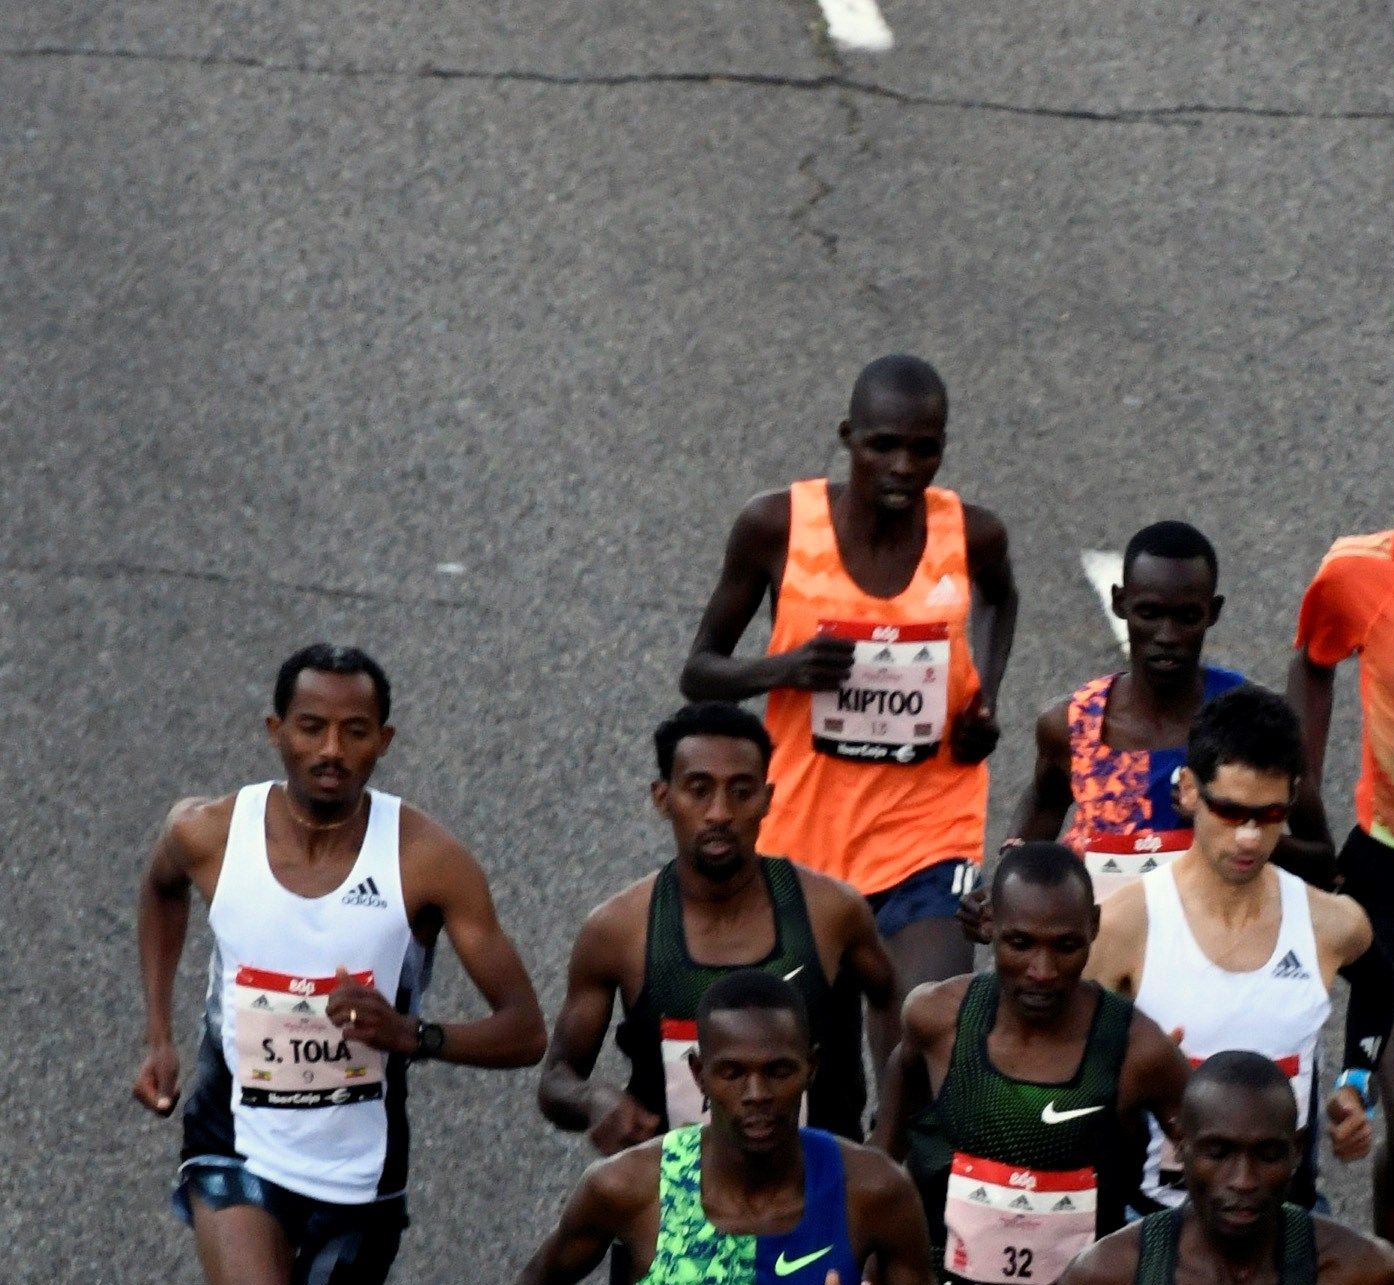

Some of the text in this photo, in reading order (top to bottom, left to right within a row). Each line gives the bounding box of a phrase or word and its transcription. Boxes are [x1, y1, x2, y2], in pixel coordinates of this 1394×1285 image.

[837, 688, 923, 715] KIPTOO
[262, 1037, 351, 1063] S. TOLA
[1002, 1246, 1034, 1278] 32
